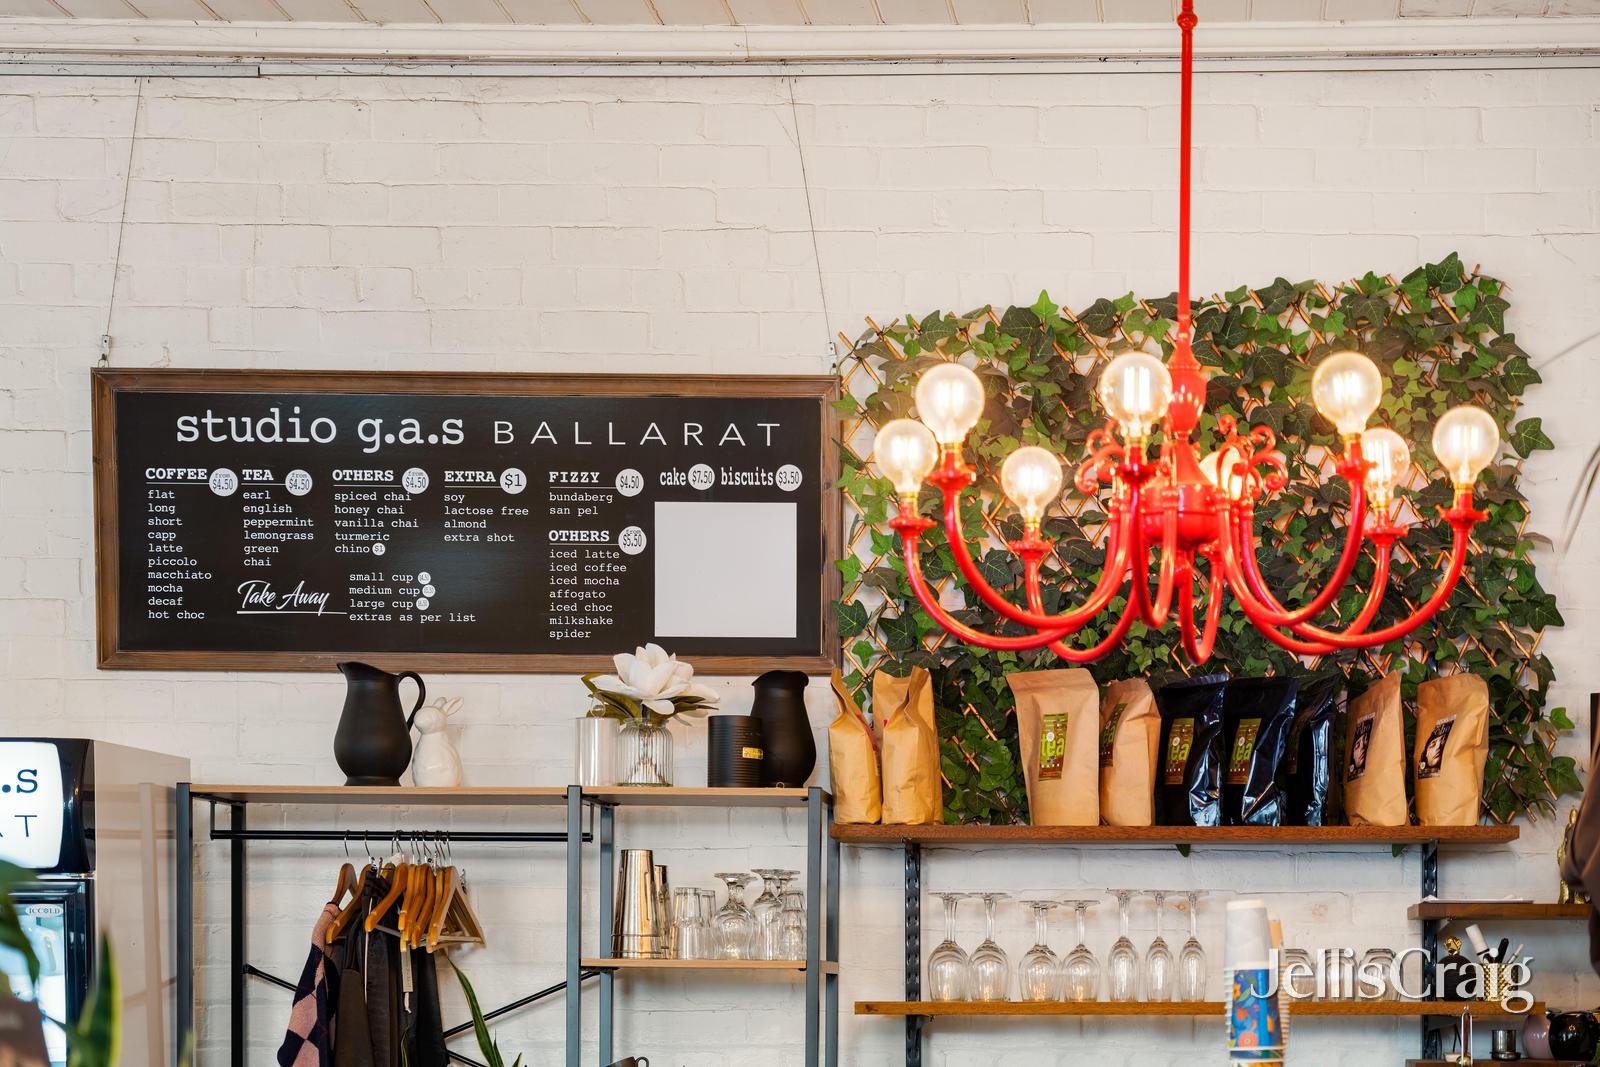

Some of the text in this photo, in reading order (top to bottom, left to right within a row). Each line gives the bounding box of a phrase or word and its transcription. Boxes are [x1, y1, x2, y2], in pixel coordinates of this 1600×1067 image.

[177, 406, 780, 453] studio g.a.s BALLARAT
[146, 468, 207, 479] COFFEE
[242, 469, 274, 480] TEA
[332, 470, 393, 481] OTHERS
[660, 467, 800, 485] cake $7.50 biscuits $3.50
[289, 478, 310, 491] $4.50
[405, 477, 426, 490] $4.50
[444, 471, 522, 488] EXTRA $1
[549, 472, 639, 489] FIZZY $4.50
[212, 479, 234, 491] $4.50
[148, 490, 175, 499] flat
[243, 491, 270, 499] earl
[335, 491, 411, 502] spiced chai
[444, 495, 464, 503] soy
[550, 492, 613, 503] bundaberg
[149, 503, 175, 514] long
[243, 504, 292, 514] english
[334, 505, 404, 516] honey chai
[445, 506, 528, 515] lactose free
[549, 506, 598, 516] san pel
[148, 517, 182, 525] short
[244, 517, 313, 528] peppermint
[335, 518, 419, 527] vanilla chai
[444, 519, 486, 528] almond
[148, 532, 176, 541] capp
[245, 531, 313, 541] lemongrass
[335, 532, 389, 540] turmeric
[444, 533, 514, 542] extra shot
[549, 530, 609, 541] OTHERS
[622, 534, 642, 548] $5.50
[149, 543, 183, 552] latte
[244, 546, 279, 554] green
[335, 544, 370, 553] chino
[550, 549, 619, 558] iced latte
[148, 557, 197, 567] piccolo
[244, 557, 271, 566] chai
[550, 562, 626, 572] iced coffee
[148, 570, 211, 579] macchiato
[350, 572, 384, 581] small
[392, 575, 413, 583] cup
[550, 576, 619, 585] iced mocha
[148, 584, 183, 592] mocha
[349, 586, 392, 594] medium
[399, 588, 420, 597] cup
[237, 580, 330, 615] Take Away
[550, 589, 605, 600] affogato
[148, 597, 182, 605] decaf
[350, 599, 384, 609] large
[392, 601, 413, 610] cup
[550, 602, 612, 611] iced choc
[149, 610, 204, 619] hot choc
[350, 613, 391, 621] extras
[420, 615, 441, 623] per
[449, 613, 476, 622] list
[550, 616, 613, 624] milkshake
[550, 629, 591, 640] spider
[1041, 733, 1065, 757] tea
